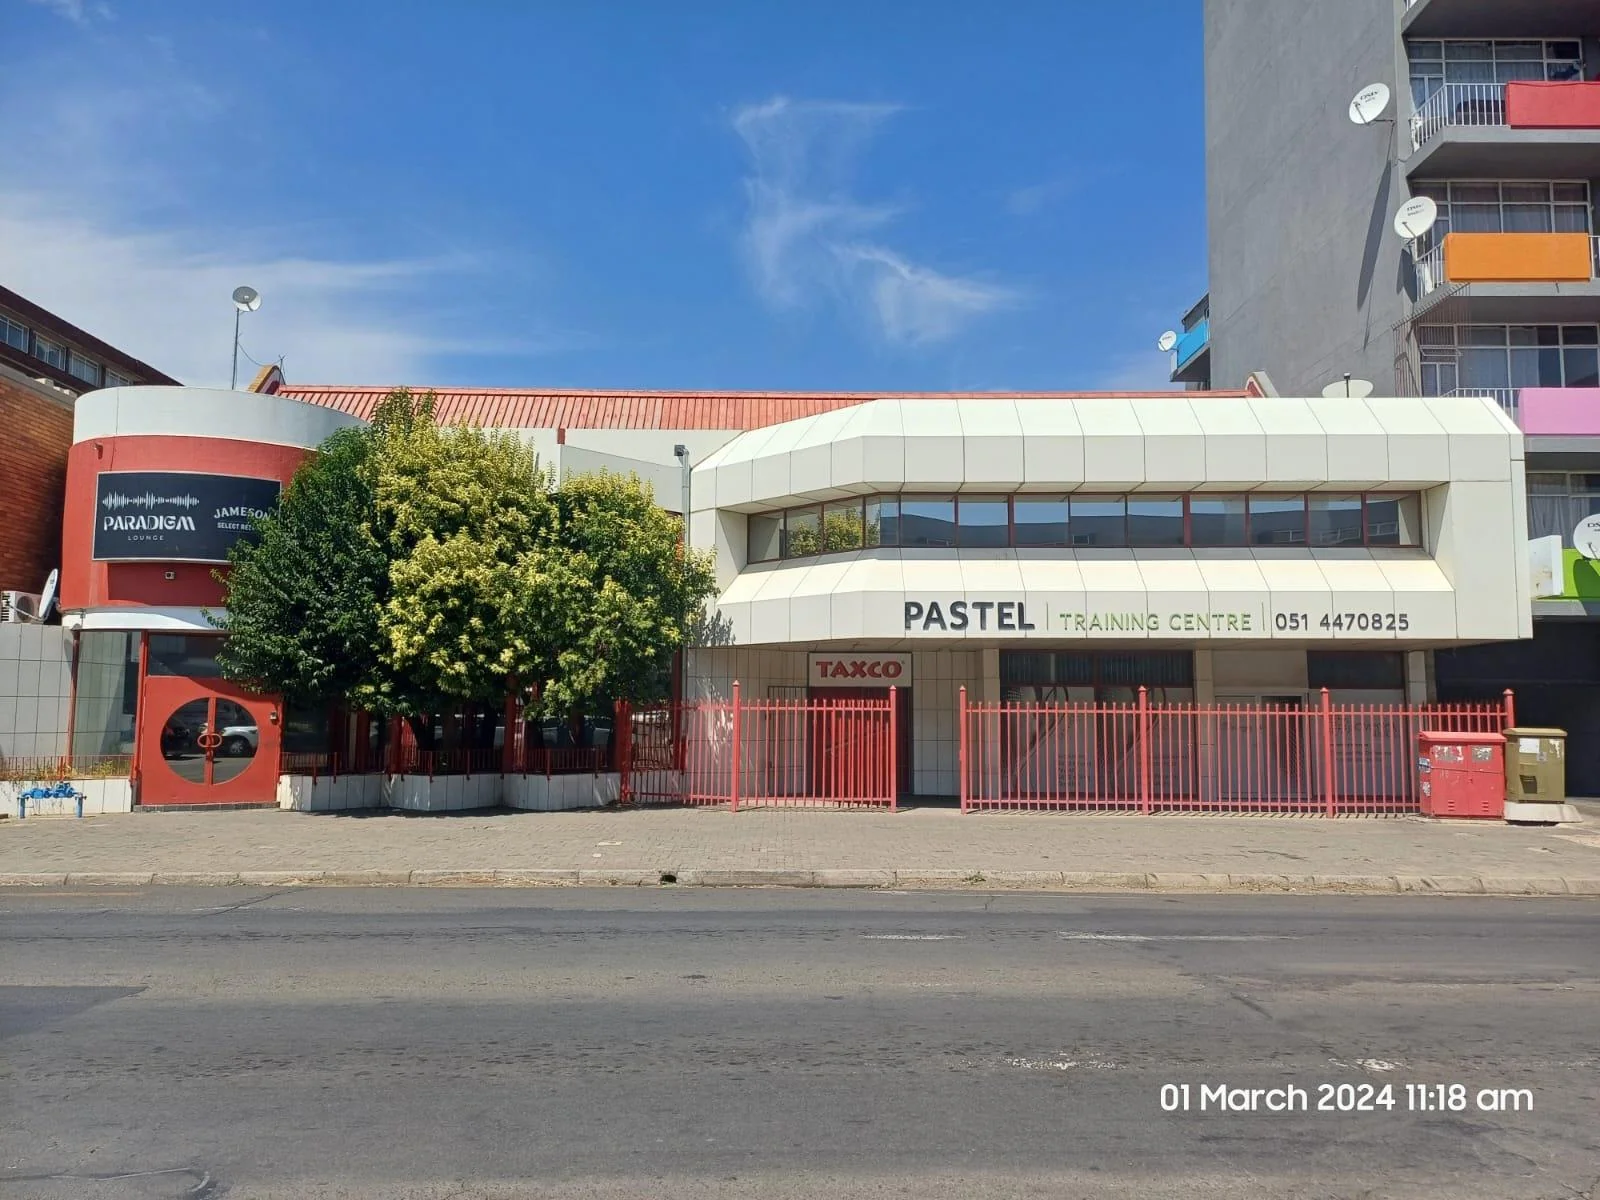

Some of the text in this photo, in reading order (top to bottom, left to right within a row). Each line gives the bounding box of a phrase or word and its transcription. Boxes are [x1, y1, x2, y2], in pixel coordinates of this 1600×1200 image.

[103, 515, 195, 531] PARADIGM
[904, 601, 1409, 631] PASTEL TRAINING CENTRE 051 4470825
[816, 660, 902, 679] TAXCO
